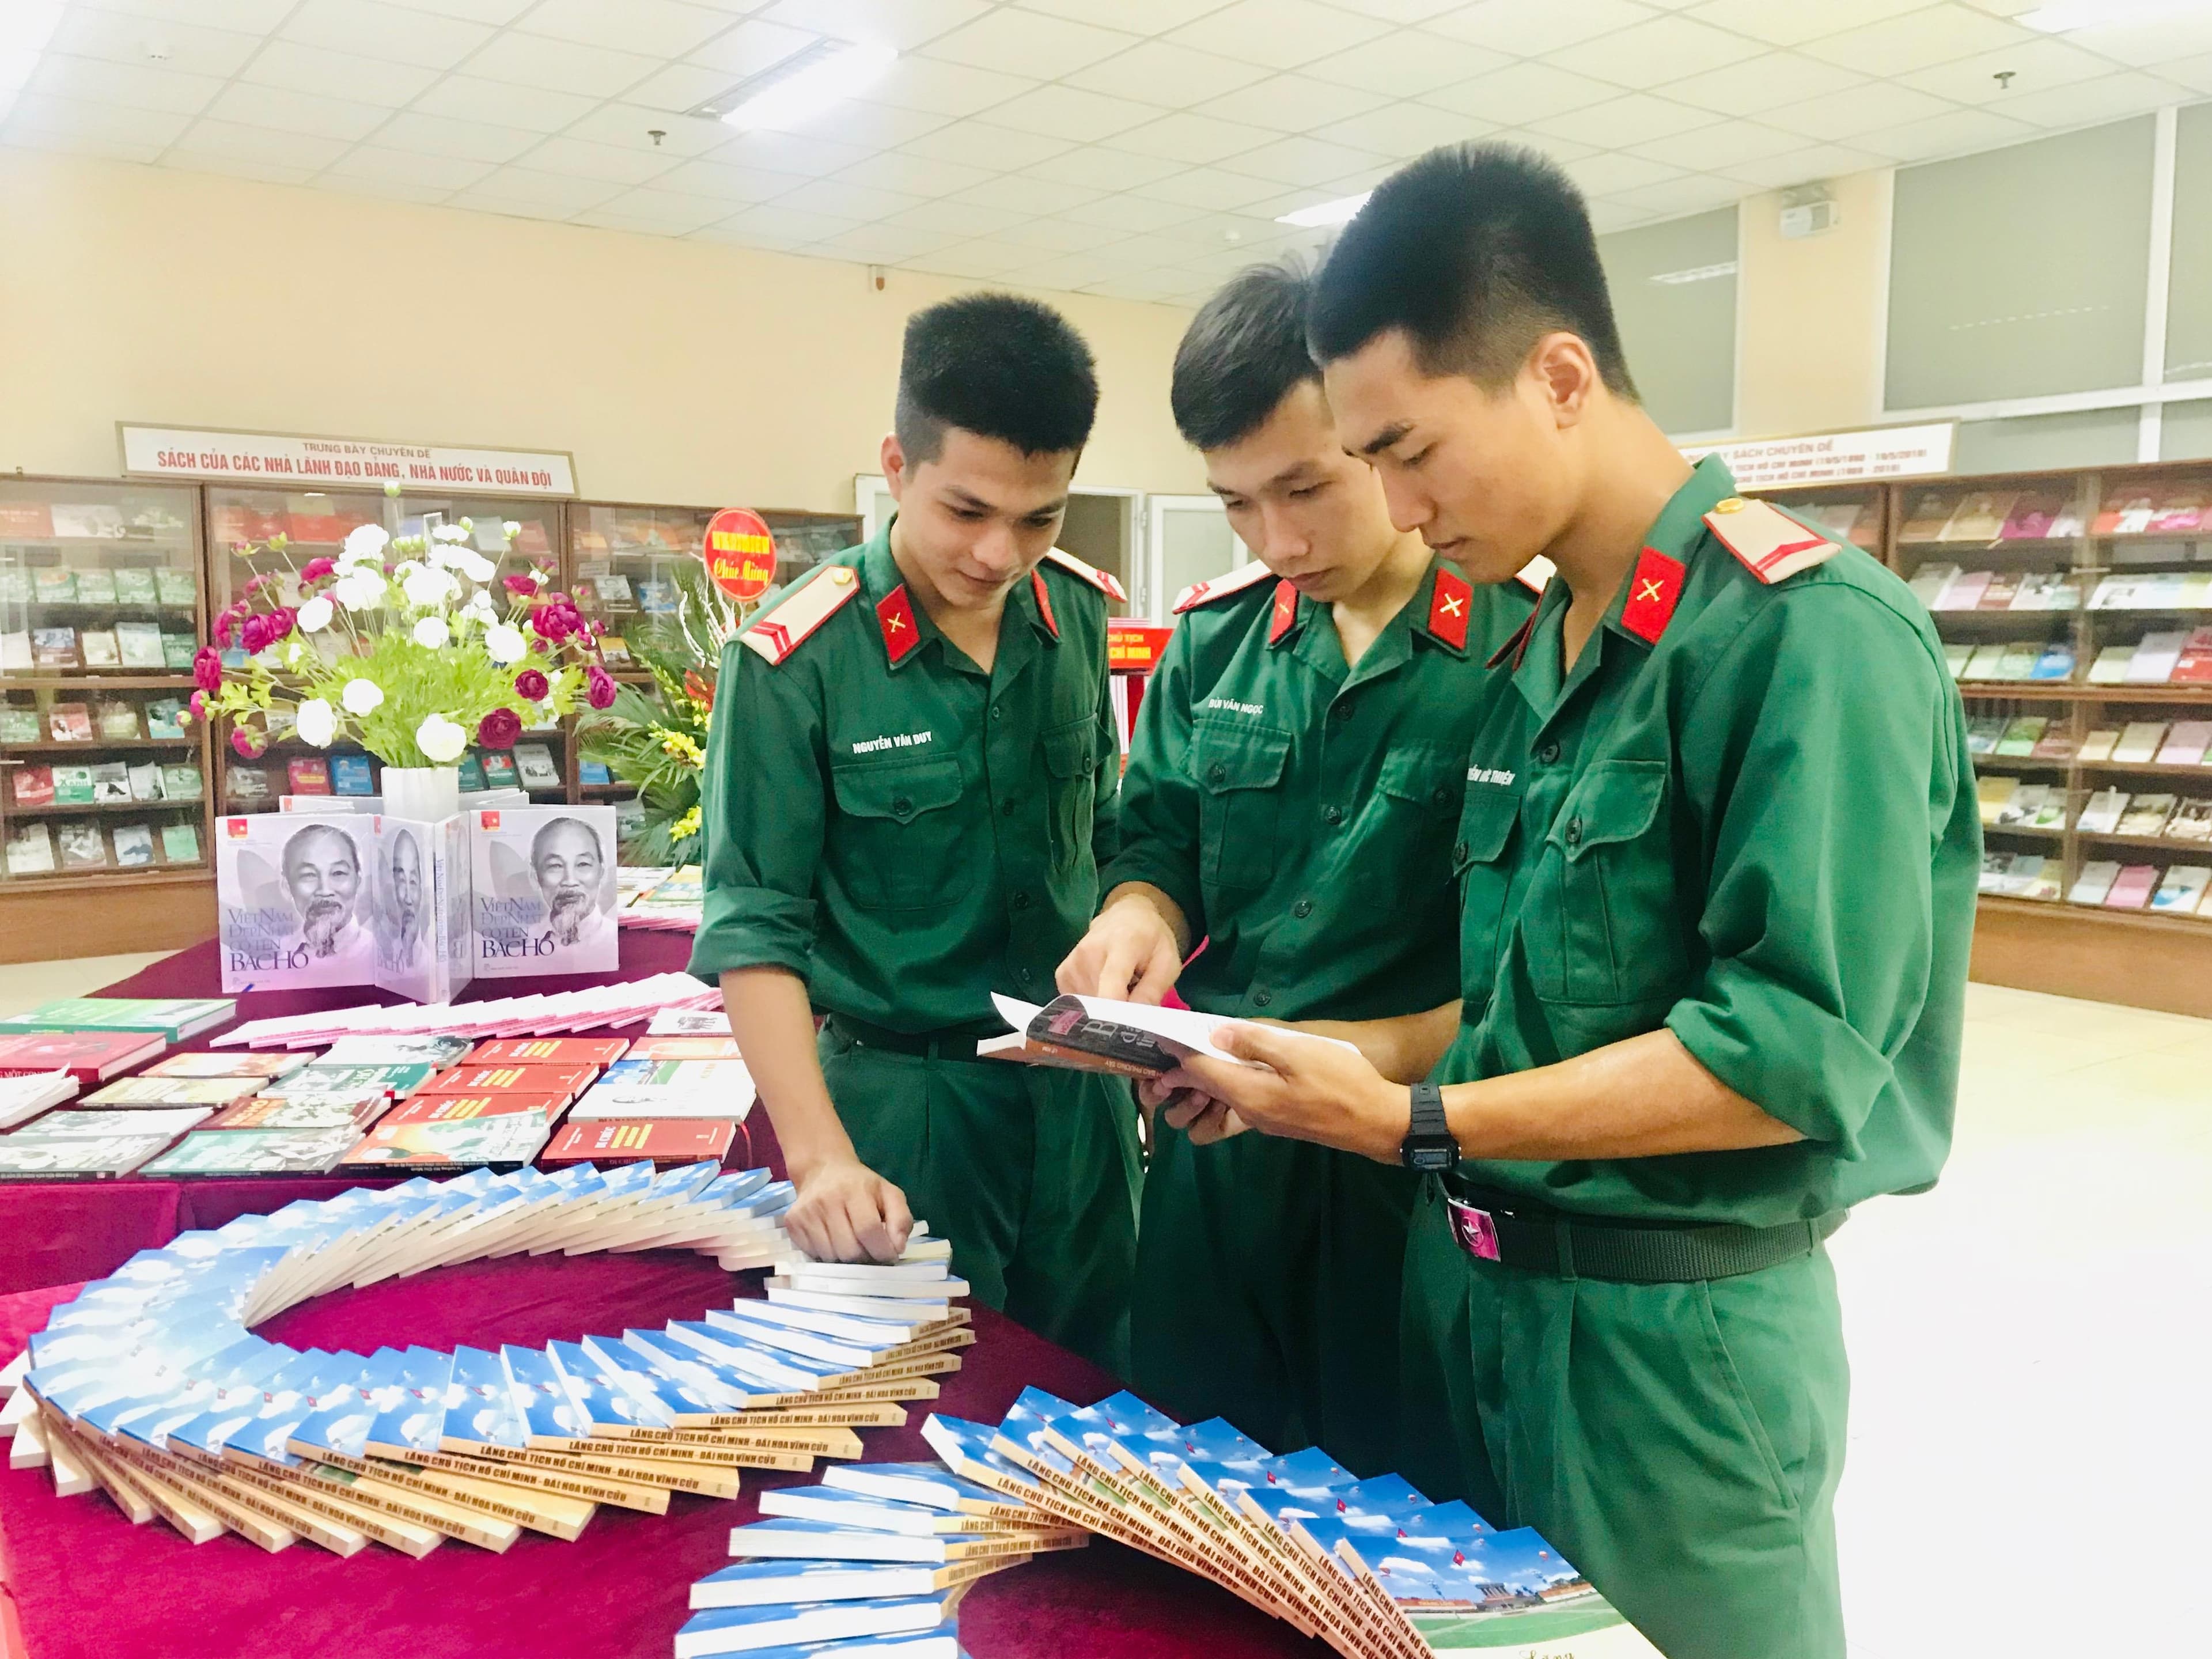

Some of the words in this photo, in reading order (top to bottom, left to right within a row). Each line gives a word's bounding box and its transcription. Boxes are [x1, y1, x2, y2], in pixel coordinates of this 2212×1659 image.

[157, 447, 196, 468] SÁCH
[200, 448, 229, 469] CỦA
[233, 452, 260, 471] CÁC
[264, 453, 293, 473] NHÀ
[297, 456, 331, 475] LÃNH
[335, 460, 361, 479] ĐẠO
[409, 462, 436, 480] NHÀ
[439, 463, 474, 482] NƯỚC
[476, 464, 493, 483] VÀ
[495, 467, 529, 485] QUÂN
[532, 469, 552, 489] ĐỘI
[853, 735, 893, 754] NGUYỄN
[893, 733, 912, 747] VĂN
[912, 731, 932, 745] DUY
[1208, 696, 1222, 709] BÙI
[1223, 698, 1240, 711] VĂN
[1240, 703, 1264, 715] NGỌC
[1202, 1492, 1225, 1515] LĂNG
[1221, 1510, 1241, 1531] CHỦ
[1237, 1526, 1259, 1548] TỊCH
[1256, 1544, 1271, 1559] HỒ
[1267, 1555, 1286, 1574] CHÍ
[1282, 1569, 1306, 1594] MINH
[1321, 1608, 1342, 1629] HOA
[1262, 1522, 1285, 1544] LĂNG
[1281, 1541, 1300, 1560] CHỦ
[1297, 1558, 1318, 1580] TỊCH
[1314, 1576, 1329, 1592] HỒ
[1325, 1588, 1343, 1607] CHÍ
[1339, 1603, 1363, 1628] MINH
[1316, 1554, 1340, 1580] LĂNG
[1336, 1575, 1355, 1596] CHỦ
[1351, 1593, 1373, 1616] TỊCH
[1369, 1612, 1385, 1629] HỒ
[1380, 1625, 1398, 1644] CHÍ
[1360, 1571, 1381, 1597] LĂNG
[1377, 1593, 1396, 1615] CHỦ
[1392, 1612, 1412, 1635] TỊCH
[1408, 1632, 1423, 1649] HỒ
